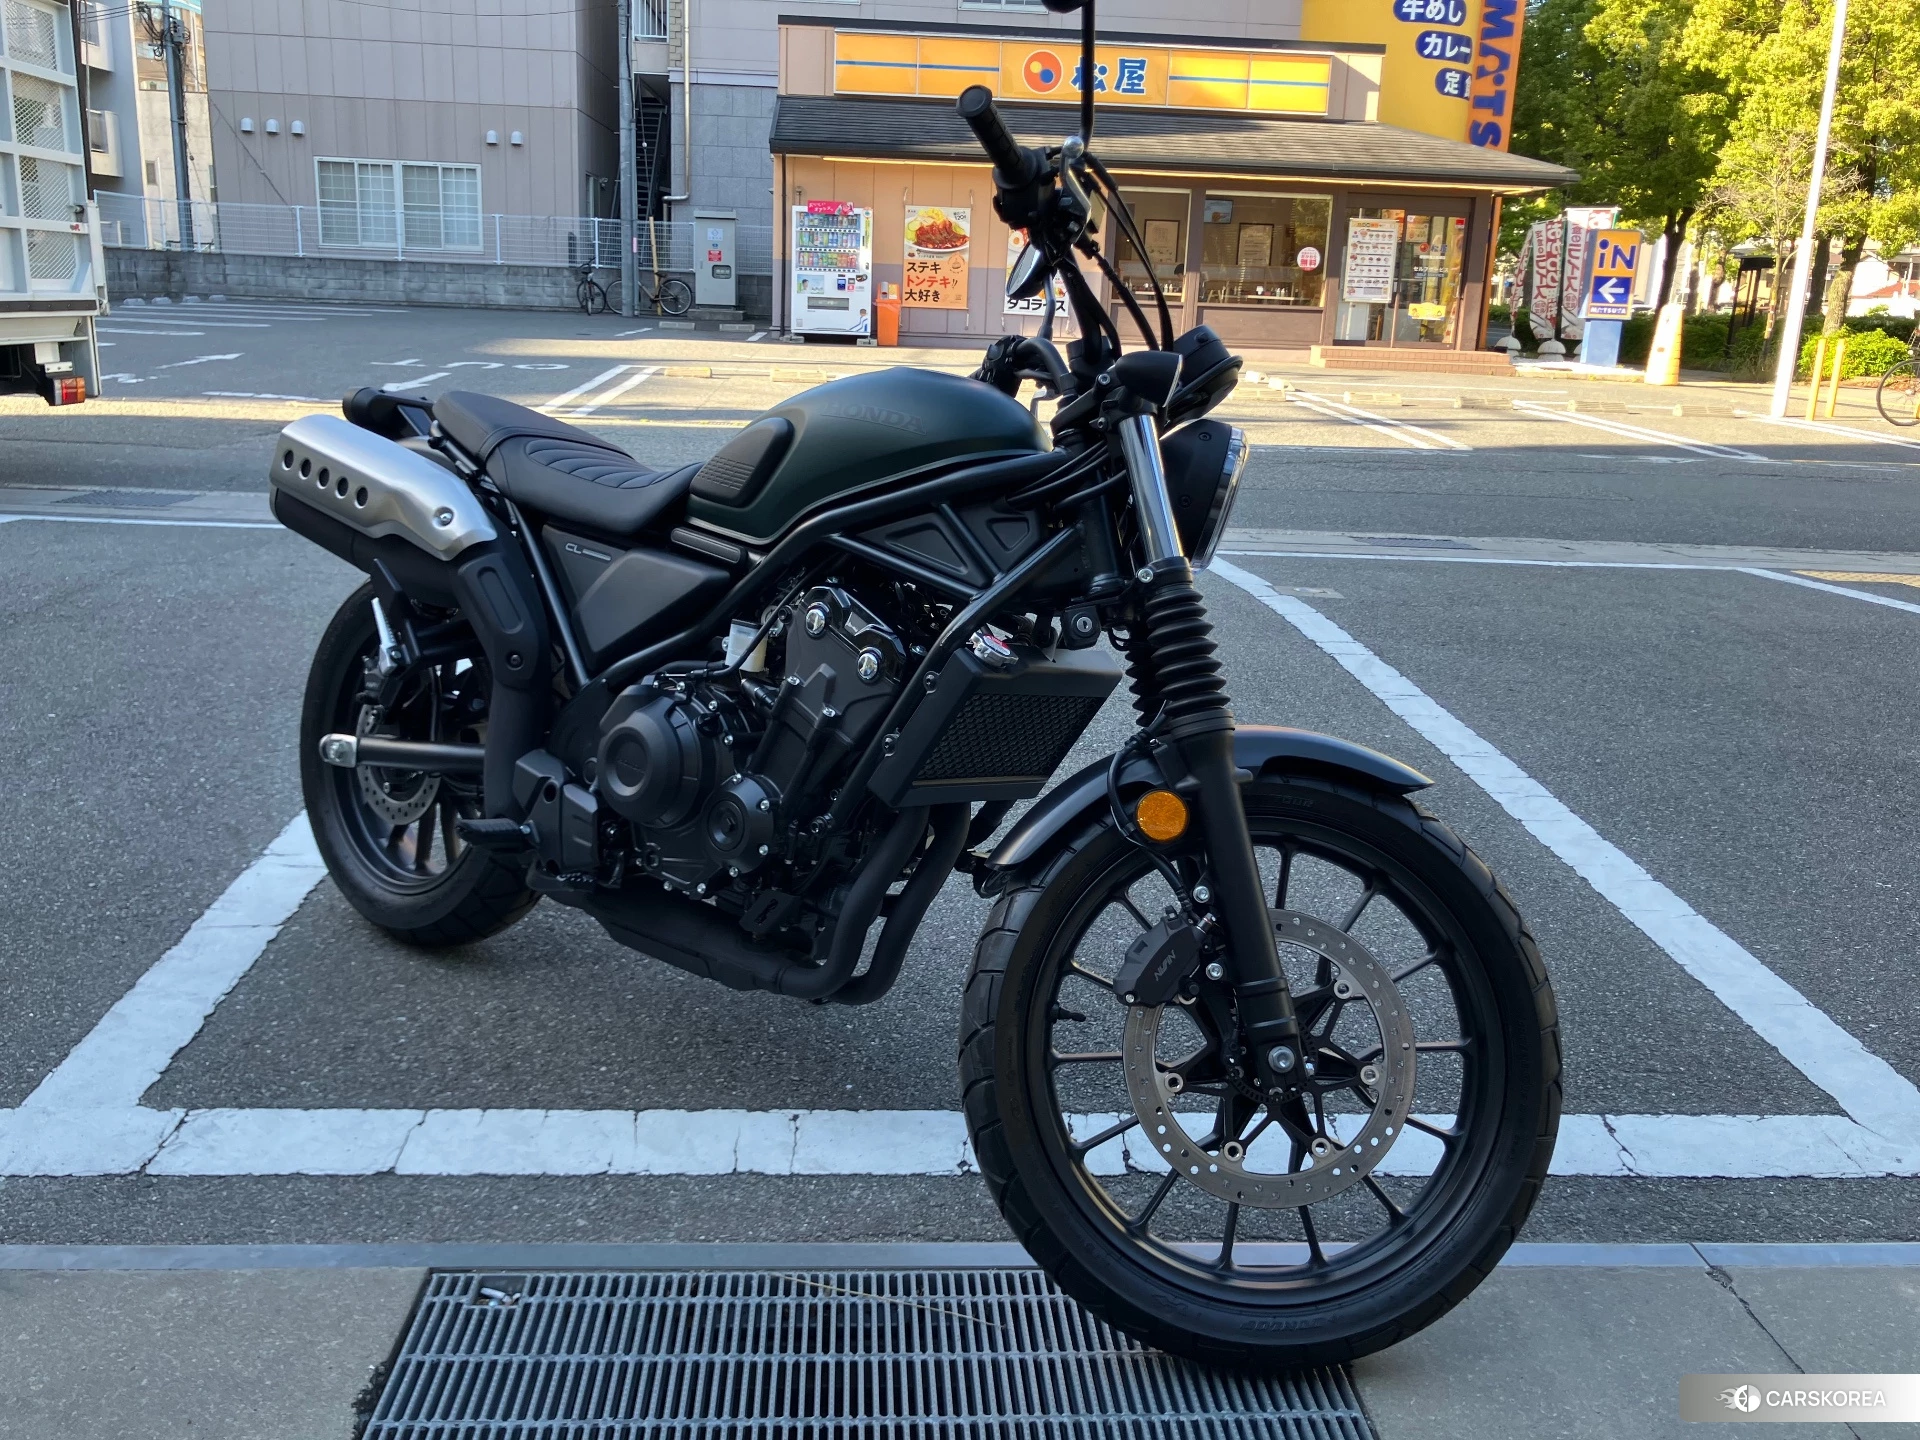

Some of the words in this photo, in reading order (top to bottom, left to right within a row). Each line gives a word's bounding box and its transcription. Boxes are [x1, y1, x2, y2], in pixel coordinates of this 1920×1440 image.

[1402, 0, 1462, 23] 牛めし
[1423, 34, 1471, 57] カレー
[1070, 56, 1148, 95] 松屋
[906, 261, 942, 274] ステキ
[1300, 259, 1317, 267] 無料
[904, 289, 941, 302] 大好き
[1007, 298, 1066, 312] タコラス
[1590, 306, 1626, 314] MATSUYA
[824, 402, 925, 432] HONDA
[565, 542, 582, 555] CL
